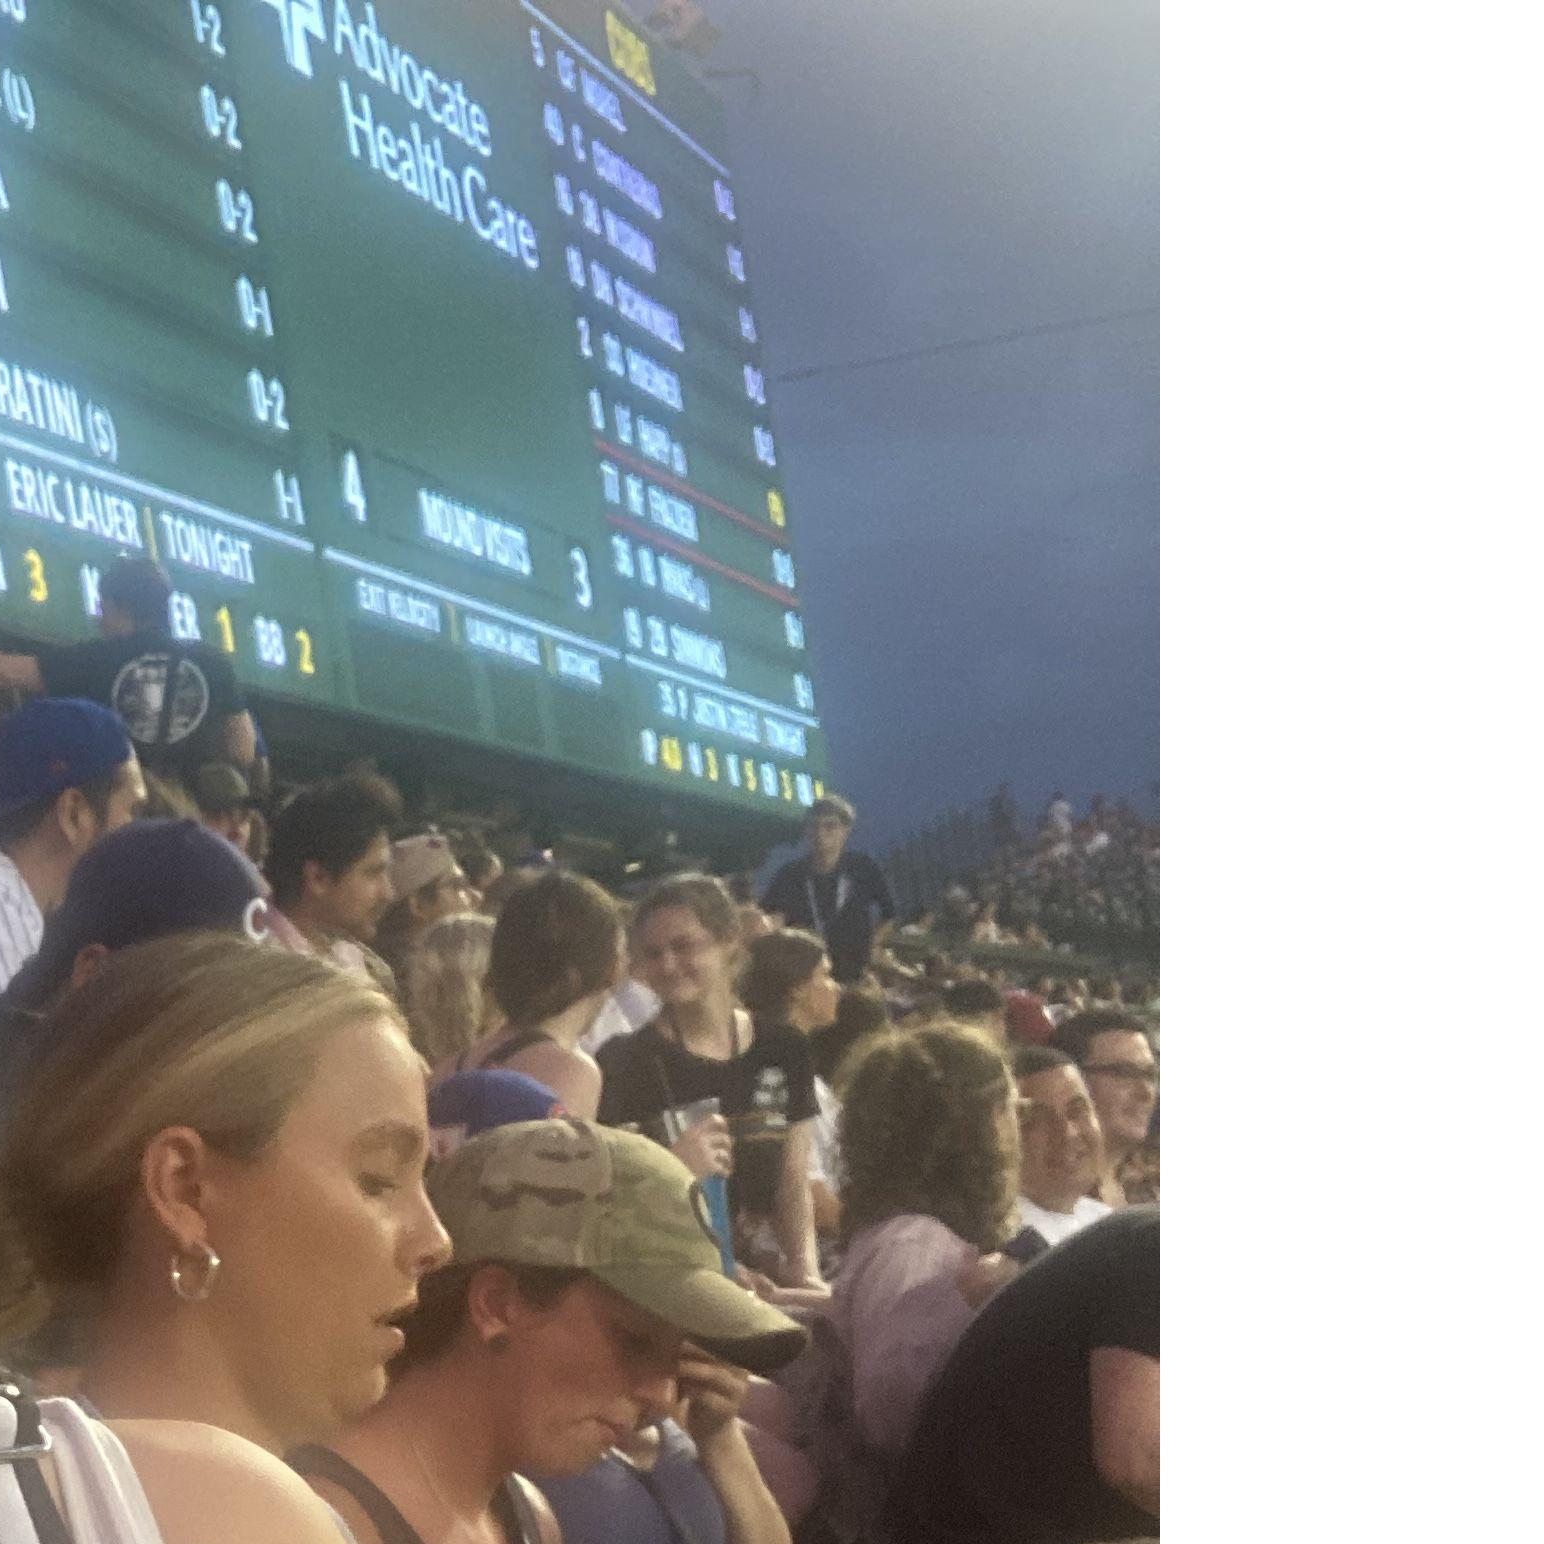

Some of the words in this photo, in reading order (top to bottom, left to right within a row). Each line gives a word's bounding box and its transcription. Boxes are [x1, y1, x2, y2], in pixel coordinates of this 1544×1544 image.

[199, 83, 243, 151] 0-2
[332, 0, 492, 157] Advocate
[215, 177, 259, 243] 0-2
[247, 367, 291, 431] 0-2
[3, 457, 67, 525] ERIC
[63, 477, 144, 549] LAUER
[159, 509, 255, 585] TONIGHT
[342, 449, 367, 522] 4
[569, 546, 594, 612] 3
[23, 548, 49, 604] 3
[167, 590, 202, 641] ER
[216, 605, 236, 653] 1
[294, 627, 316, 676] 2
